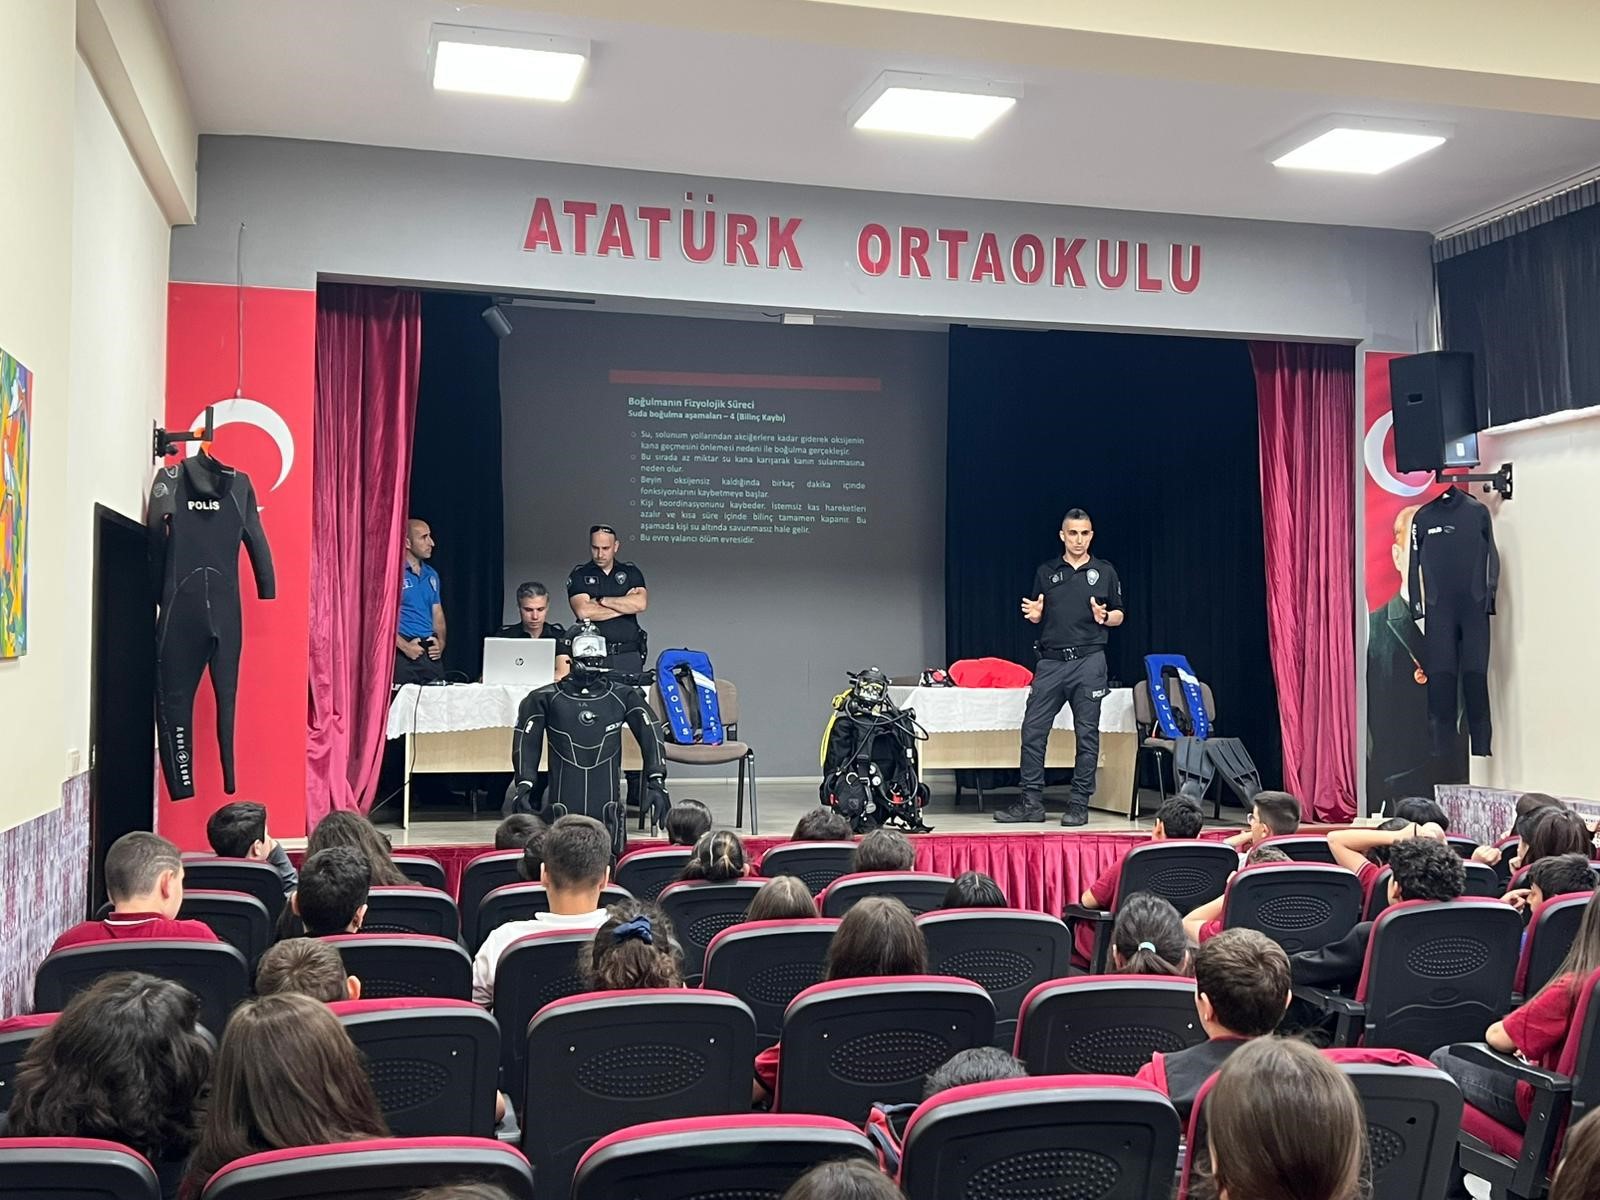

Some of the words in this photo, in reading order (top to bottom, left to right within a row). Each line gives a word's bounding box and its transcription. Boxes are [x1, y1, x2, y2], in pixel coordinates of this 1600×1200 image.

[522, 191, 804, 270] ATATÜRK
[856, 223, 1202, 294] ORTAOKULU
[628, 397, 682, 408] Boğulmanın
[684, 399, 726, 410] Fizyolojik
[728, 400, 754, 410] Süreci
[628, 410, 648, 418] Suda
[649, 410, 682, 419] boğulma
[684, 412, 722, 420] aşamaları
[736, 414, 760, 422] (Bilinç
[762, 414, 786, 423] Kaybı)
[640, 431, 653, 440] Su,
[655, 431, 688, 439] solunum
[690, 432, 732, 440] yollarından
[734, 432, 774, 442] akciğerlere
[777, 434, 798, 442] kadar
[800, 435, 828, 444] giderek
[831, 436, 864, 446] oksijenin
[660, 443, 699, 452] geçmesini
[700, 444, 734, 452] önlemesi
[774, 446, 807, 454] boğulma
[756, 456, 790, 465] karışarak
[818, 458, 865, 467] sulanmasına
[640, 476, 662, 485] Beyin
[674, 477, 710, 486] oksijensiz
[722, 478, 760, 487] kaldığında
[772, 480, 796, 489] birkaç
[843, 482, 866, 490] içinde
[640, 487, 696, 497] fonksiyonlarını
[698, 489, 744, 498] kaybetmeye
[187, 499, 220, 510] POLİS
[640, 499, 654, 507] Kişi
[659, 500, 724, 508] koordinasyonunu
[730, 502, 766, 510] kaybeder.
[825, 504, 866, 513] hareketleri
[724, 513, 747, 521] içinde
[753, 513, 773, 522] bilinç
[640, 522, 674, 530] aşamada
[670, 534, 698, 543] yalancı
[1092, 688, 1106, 698] POLI
[176, 726, 185, 750] AQUA
[180, 764, 191, 786] LUNG
